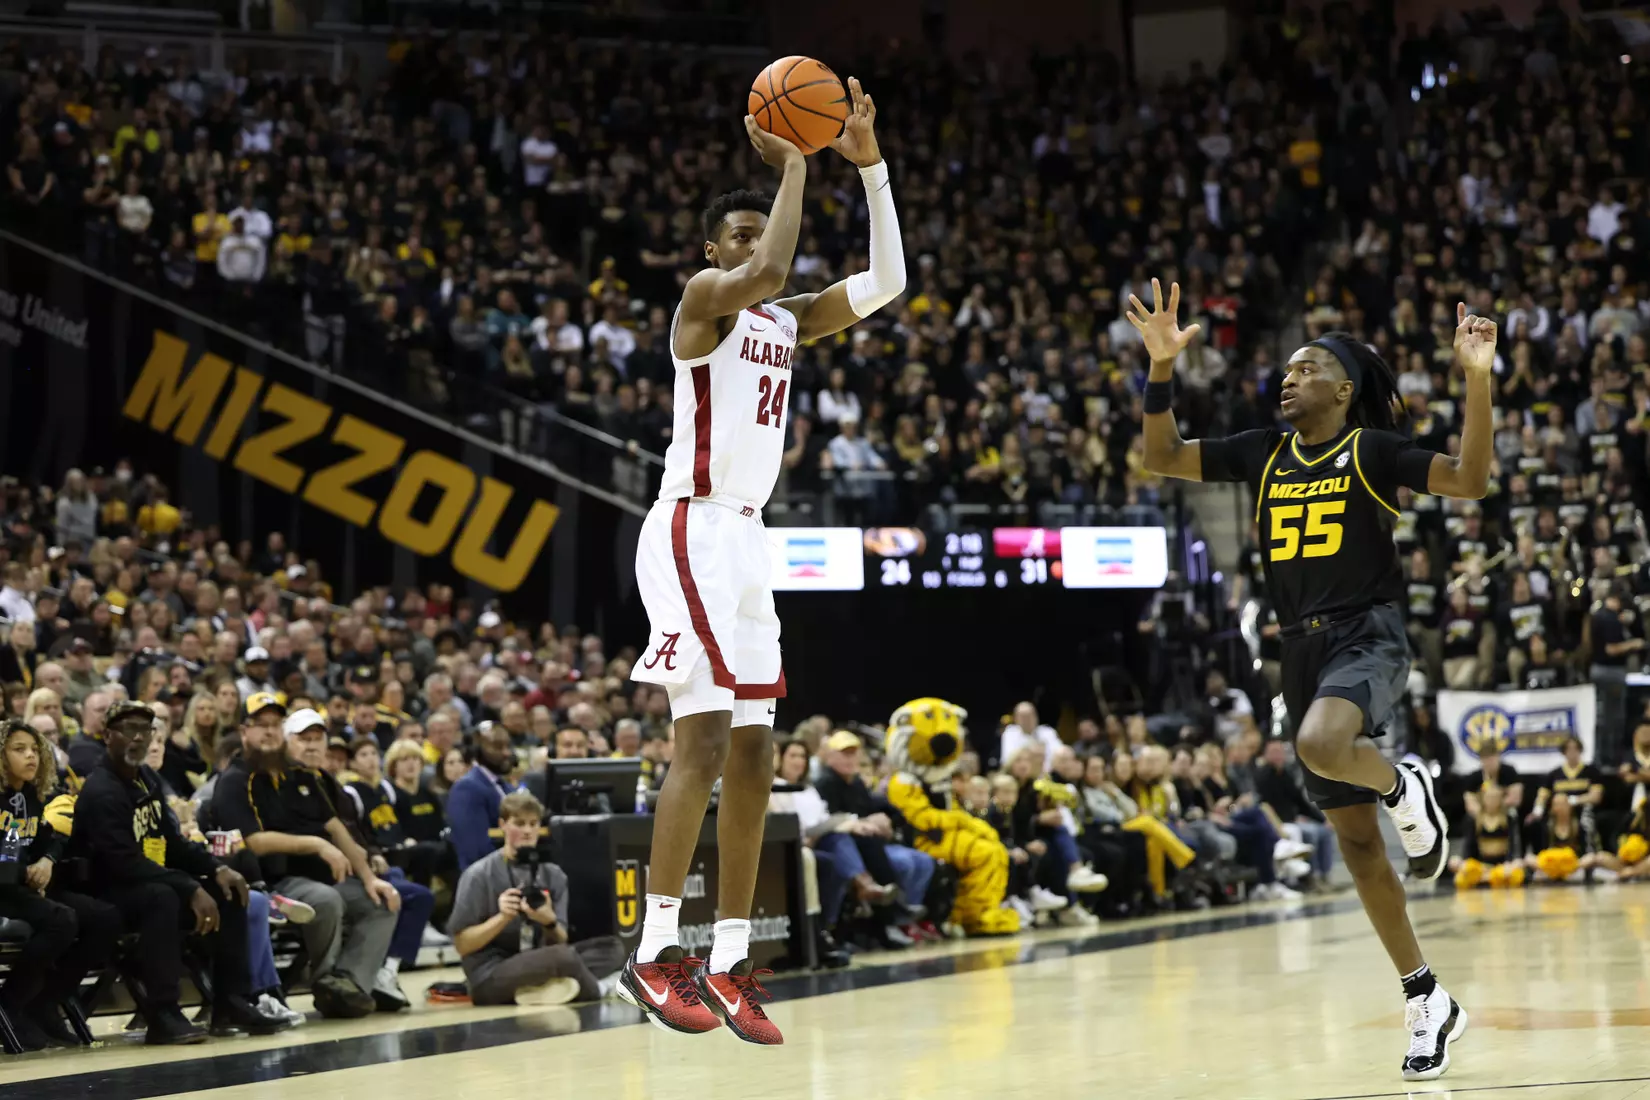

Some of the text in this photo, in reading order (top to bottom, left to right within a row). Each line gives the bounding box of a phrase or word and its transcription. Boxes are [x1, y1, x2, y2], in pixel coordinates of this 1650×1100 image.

[756, 375, 787, 429] 24
[122, 329, 560, 591] MIZZOU
[1268, 476, 1351, 499] MIZZOU
[1269, 500, 1347, 563] 55
[880, 558, 912, 586] 24
[1020, 558, 1048, 584] 31
[644, 631, 681, 670] A
